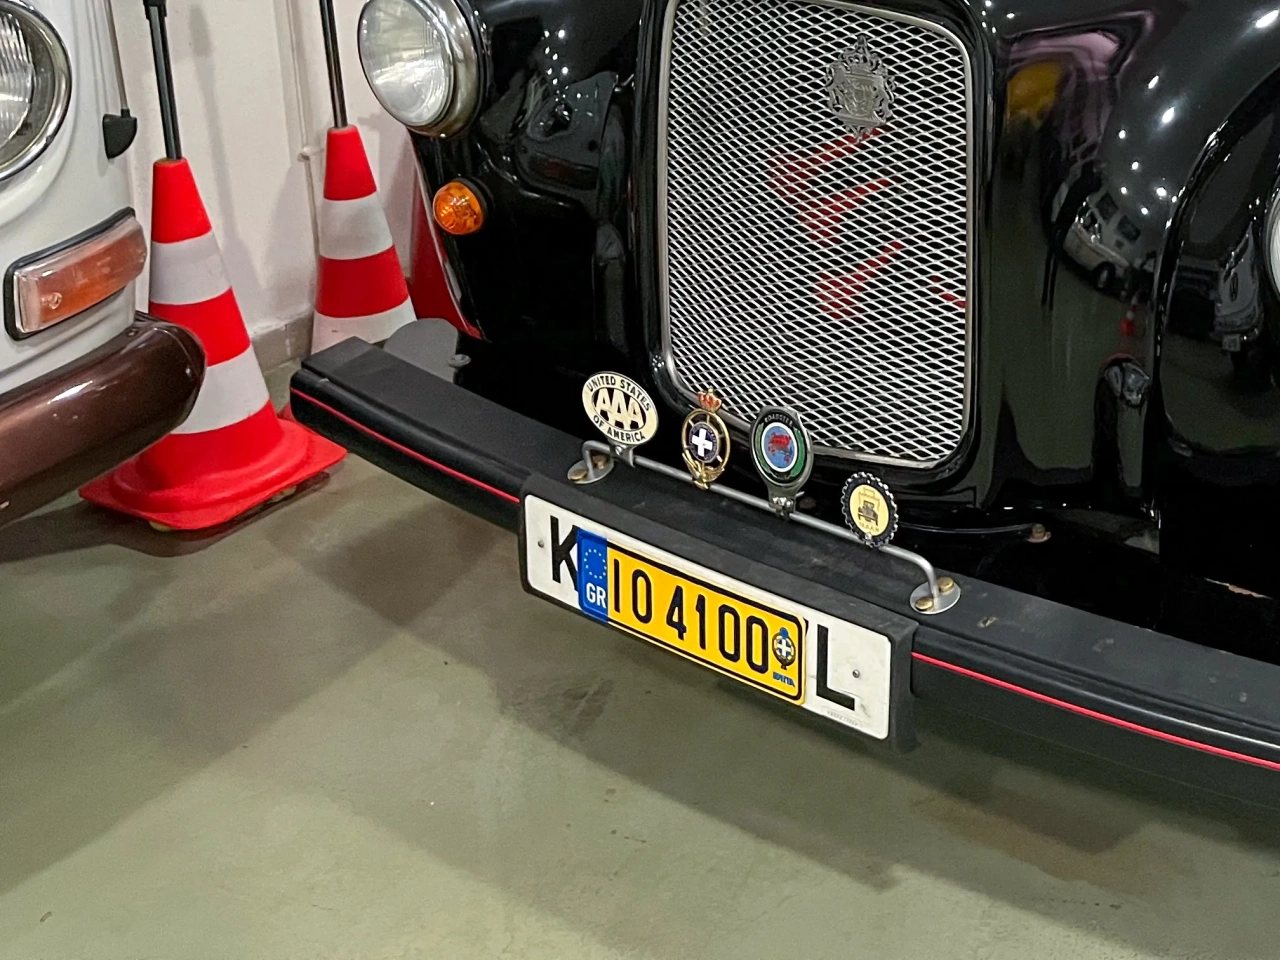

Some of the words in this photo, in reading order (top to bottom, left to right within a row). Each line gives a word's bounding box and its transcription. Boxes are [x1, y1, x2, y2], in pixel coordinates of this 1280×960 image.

[586, 375, 616, 393] UNITED
[619, 379, 652, 412] STATES
[595, 387, 645, 431] AAA
[593, 414, 605, 428] OF
[606, 426, 646, 443] AMERICA
[585, 582, 607, 609] GR
[665, 585, 769, 674] 4100
[816, 623, 856, 712] L
